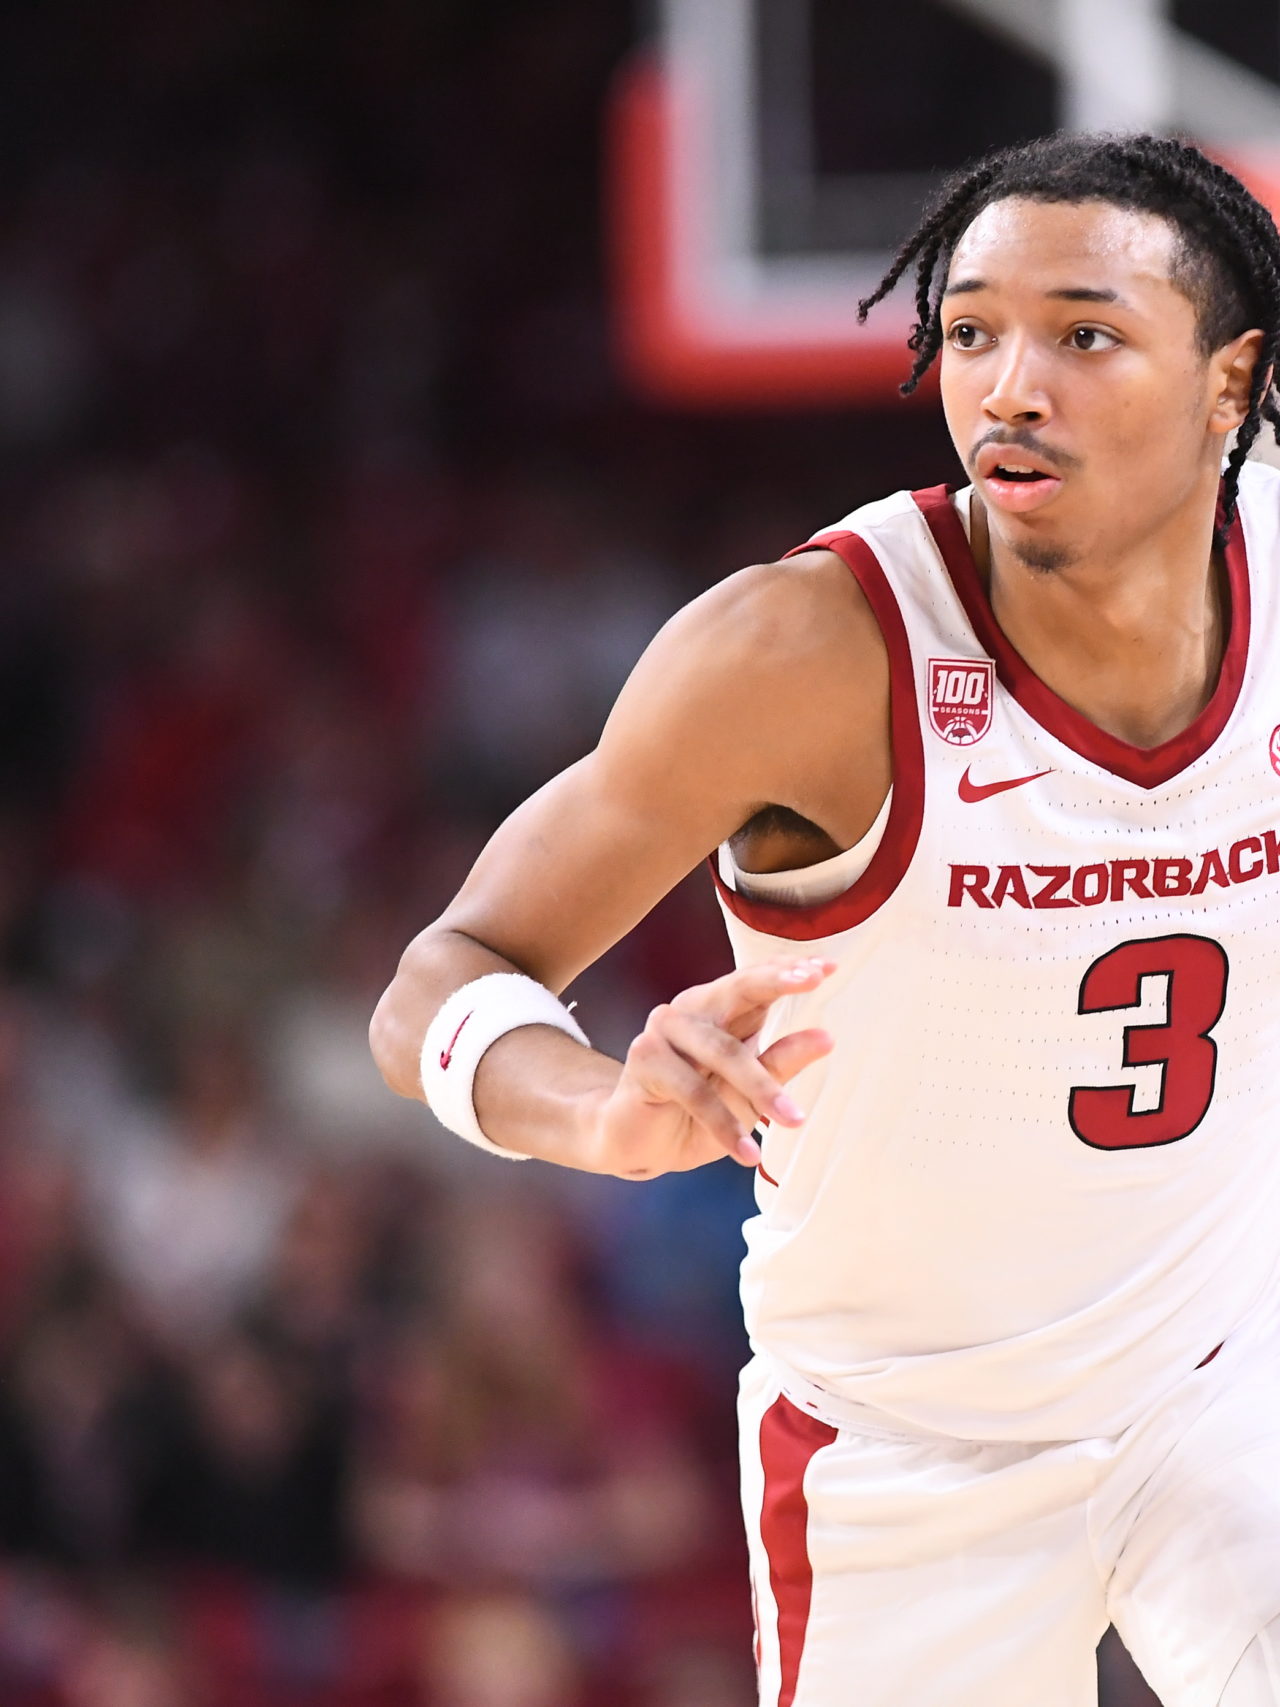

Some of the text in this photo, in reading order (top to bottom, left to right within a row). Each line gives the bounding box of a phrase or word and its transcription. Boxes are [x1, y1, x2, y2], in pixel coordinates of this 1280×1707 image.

[936, 669, 986, 705] 100
[940, 706, 980, 716] SEASONS
[1067, 932, 1230, 1152] 3
